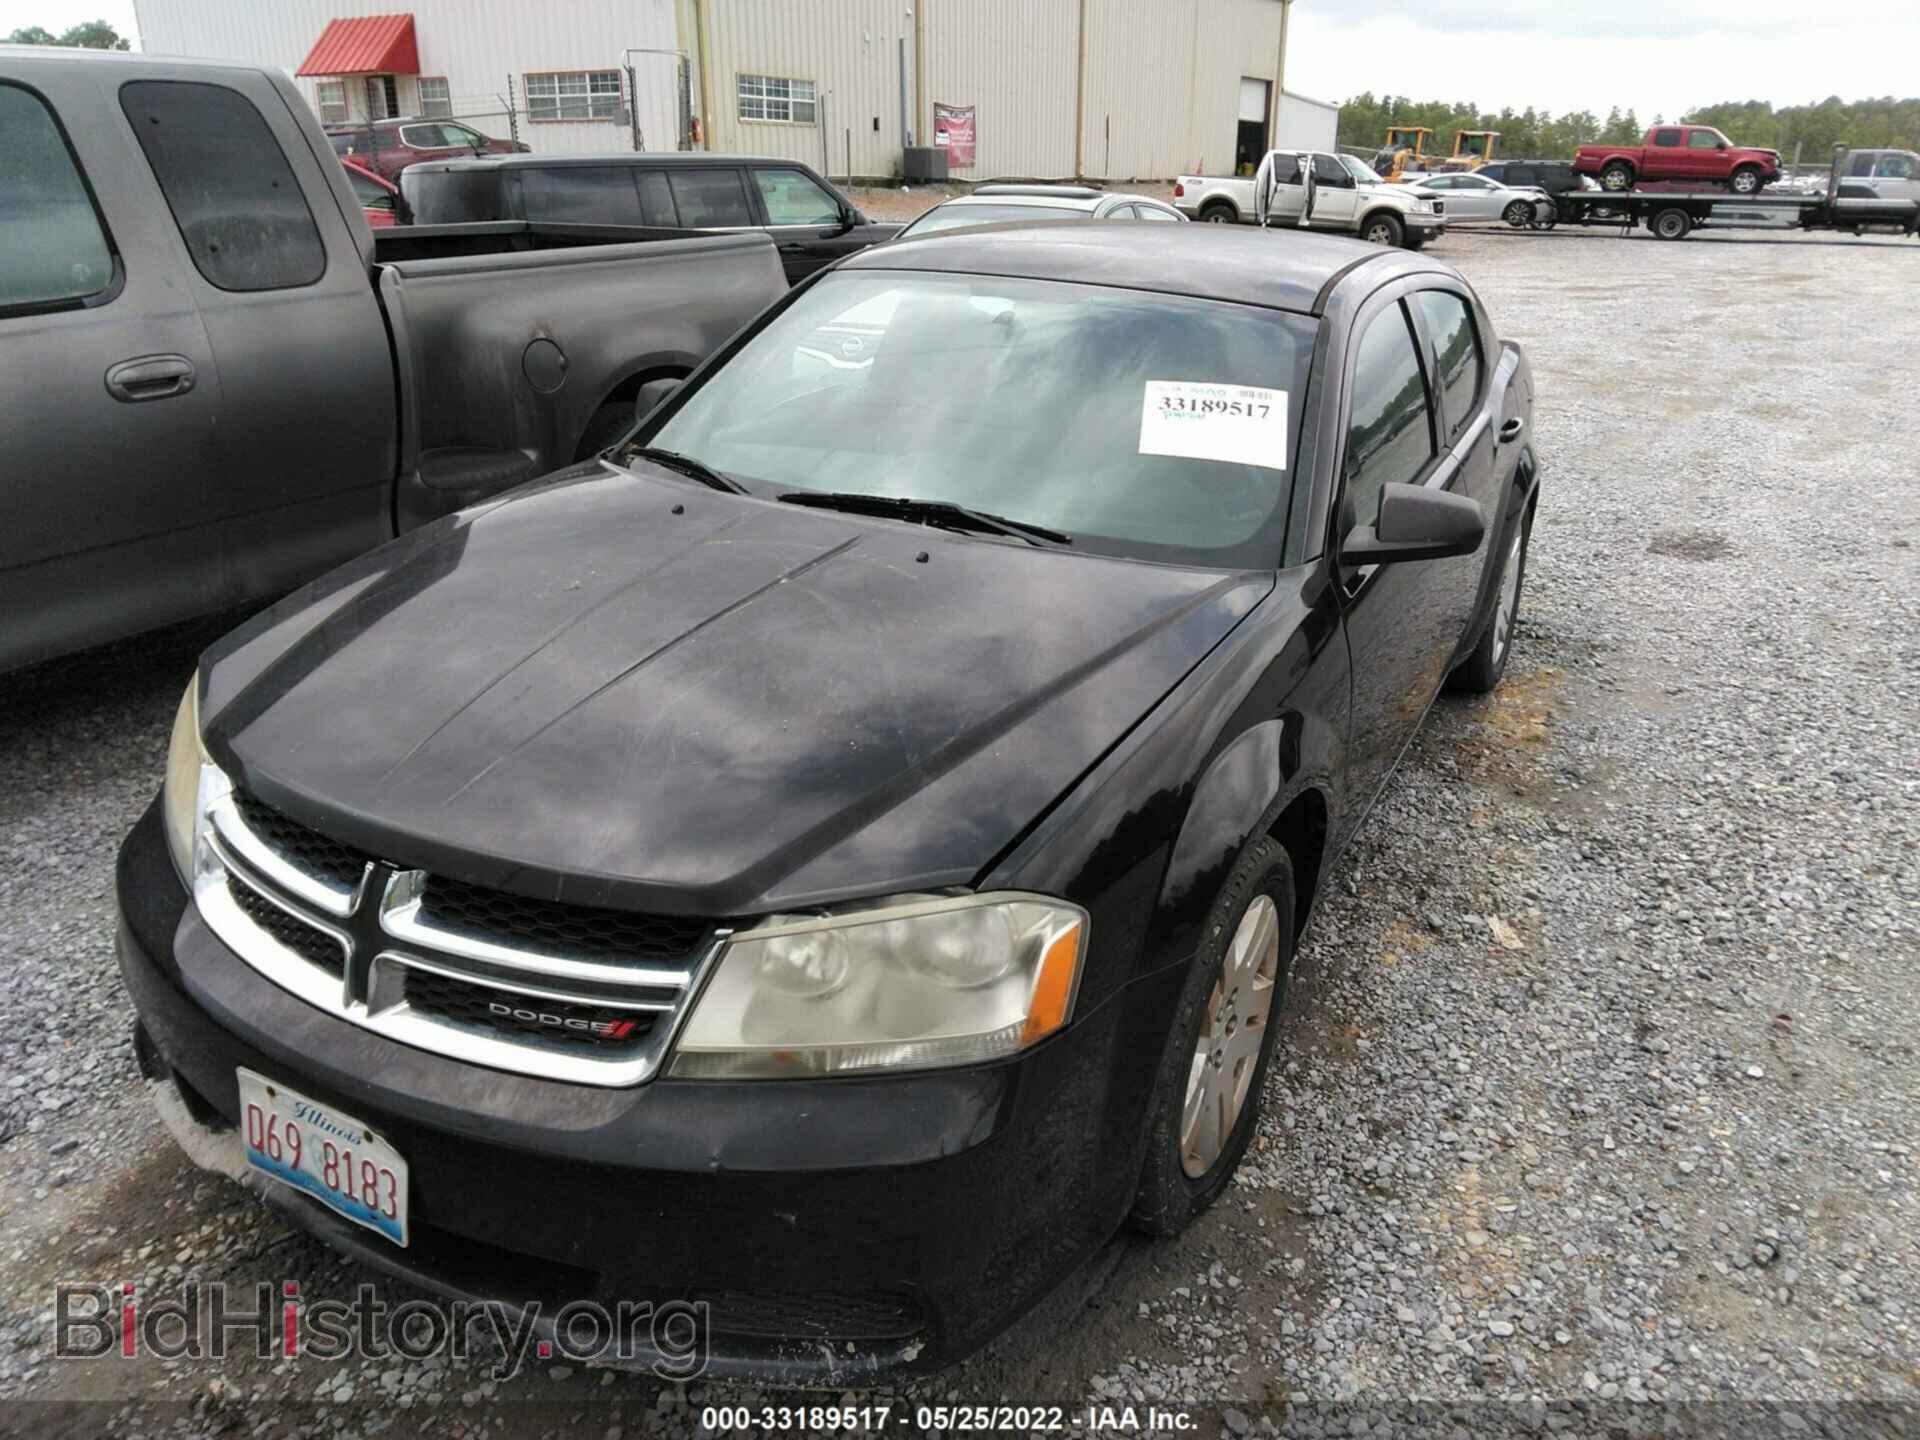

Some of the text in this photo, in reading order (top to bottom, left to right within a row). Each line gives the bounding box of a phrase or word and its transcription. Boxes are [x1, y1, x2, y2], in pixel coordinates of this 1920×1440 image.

[1158, 397, 1270, 419] 33189517
[489, 1003, 614, 1034] DODGE
[294, 1102, 361, 1146] Illinois
[323, 1142, 397, 1220] 8183
